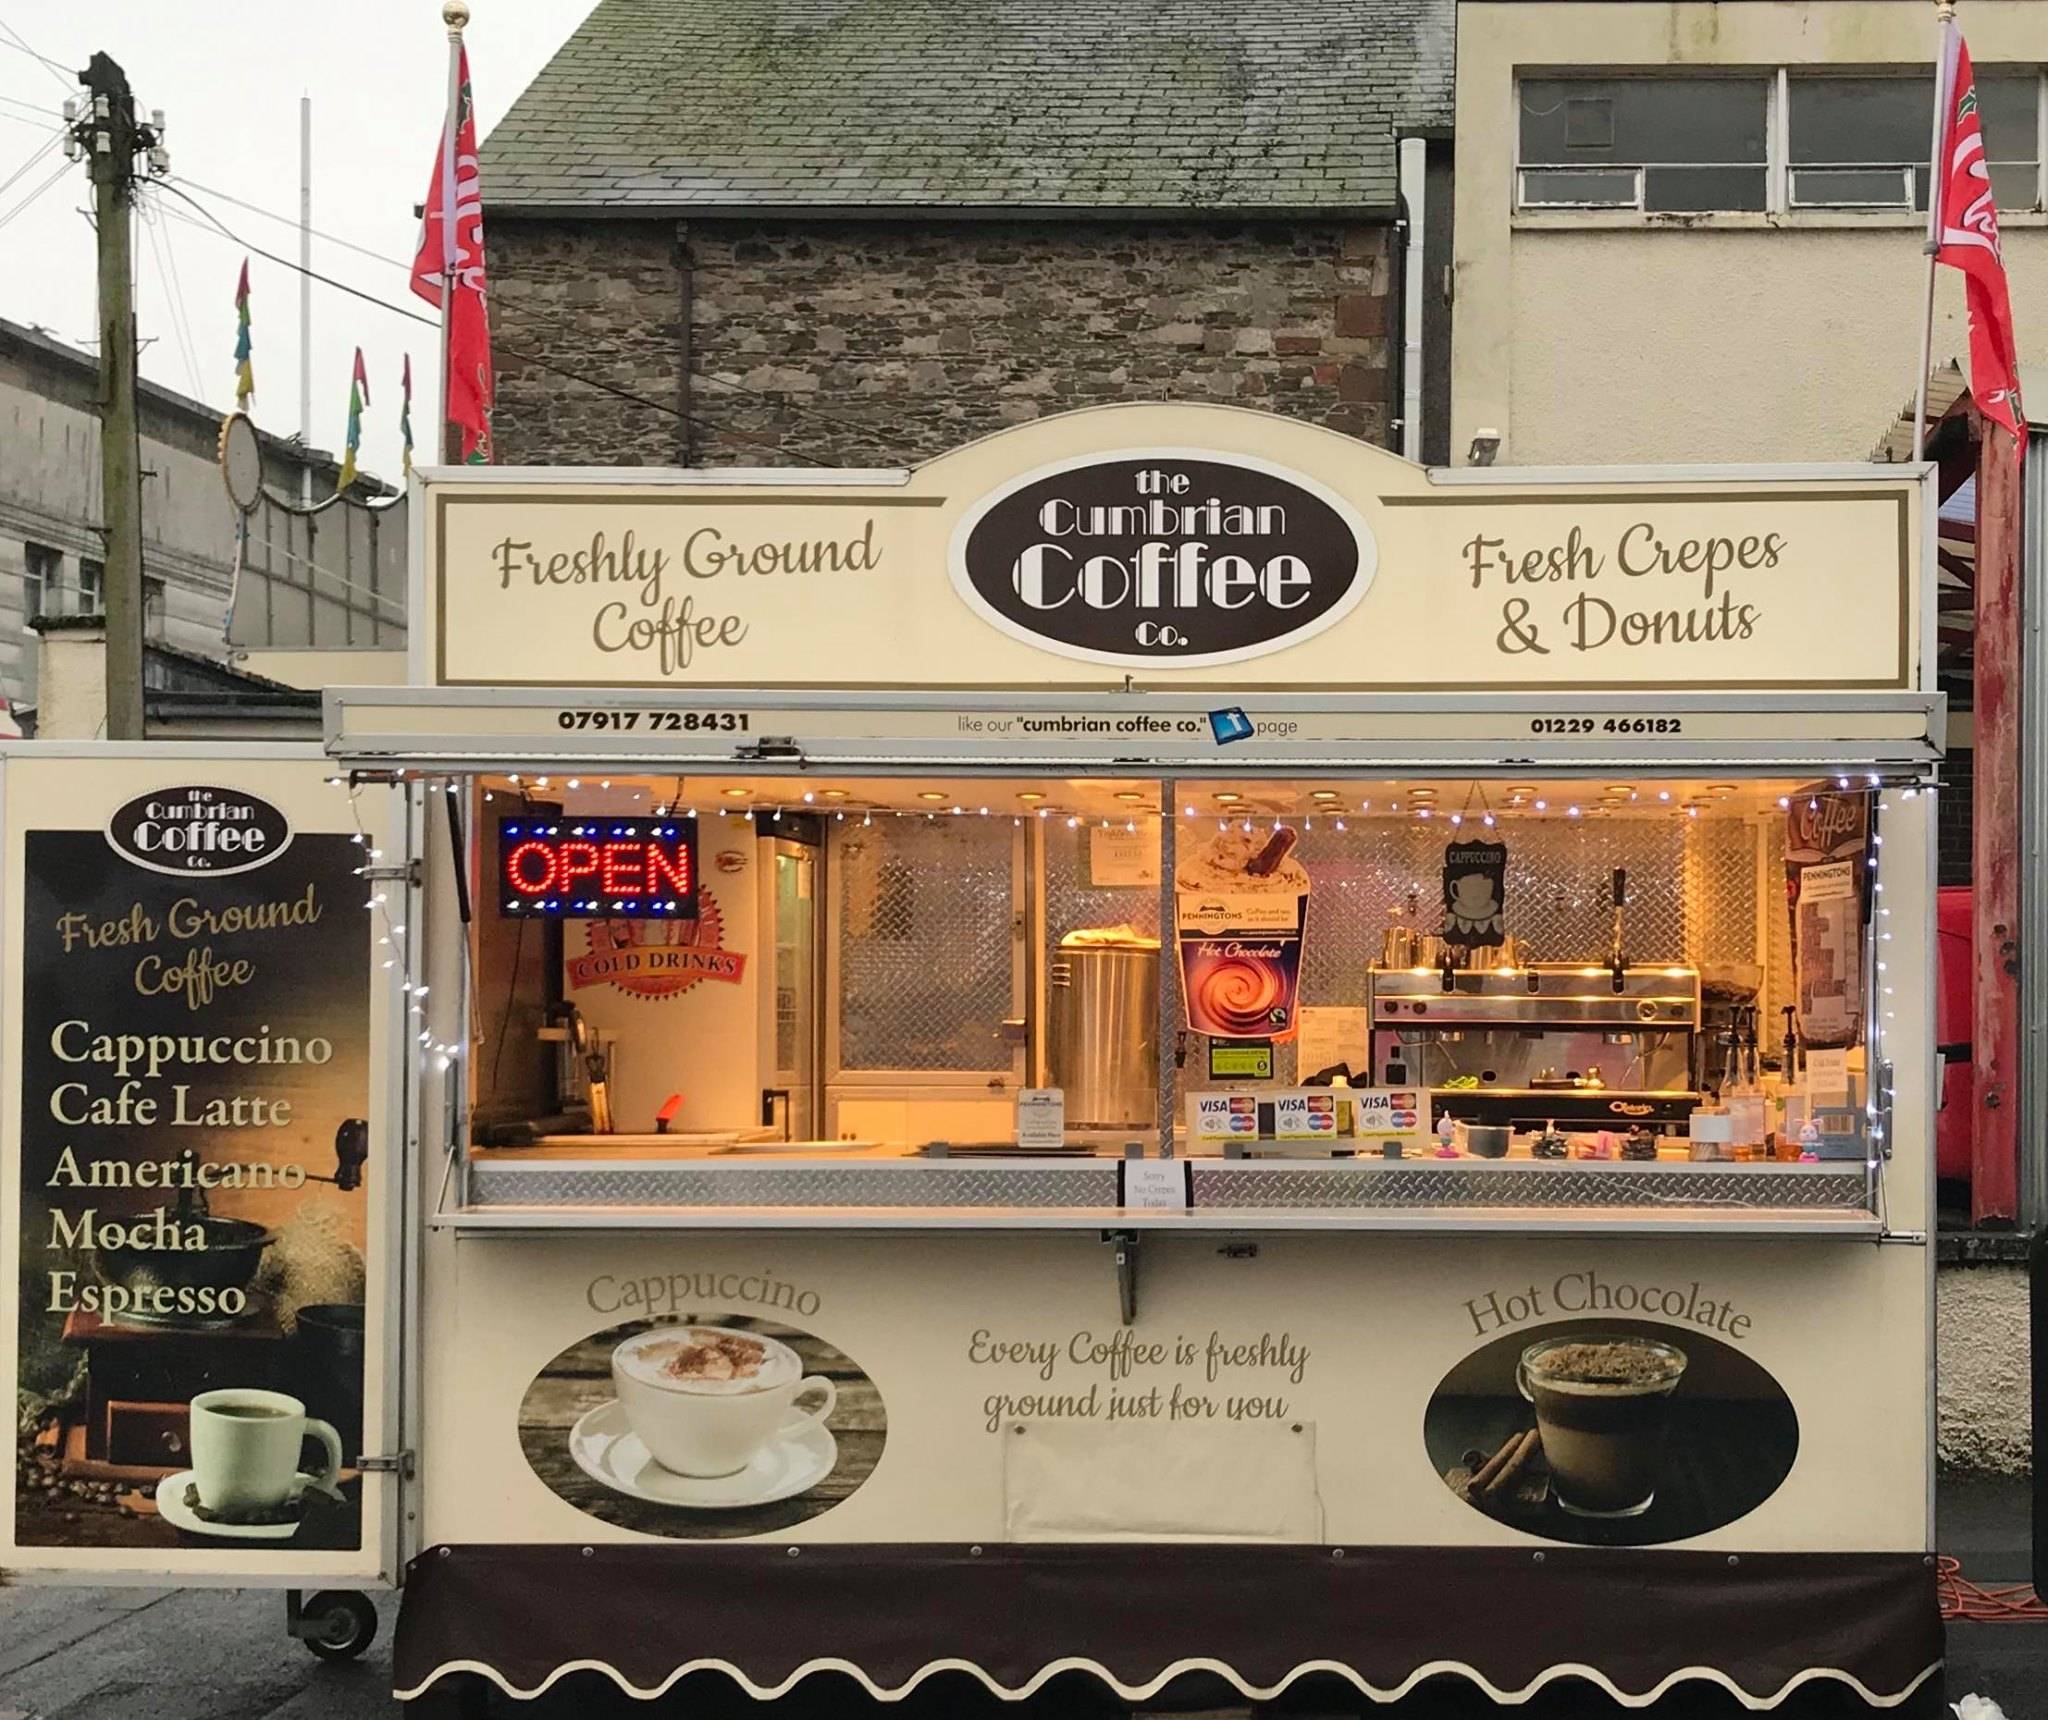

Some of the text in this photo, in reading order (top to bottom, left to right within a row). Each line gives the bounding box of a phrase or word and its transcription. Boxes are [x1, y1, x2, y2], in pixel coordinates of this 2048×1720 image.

[1134, 469, 1190, 495] the
[1039, 498, 1286, 536] Cumbrian
[492, 518, 882, 606] Freshly Ground
[1012, 541, 1312, 610] Coffee
[1462, 522, 1788, 600] Fresh Crepes
[593, 594, 749, 676] Coffee
[1135, 621, 1189, 647] Co.
[1496, 590, 1762, 655] & Donuts
[558, 711, 750, 731] 07917 728431
[958, 716, 983, 732] like
[987, 719, 1014, 732] our
[1016, 716, 1111, 733] "cumbrian
[1115, 716, 1172, 733] coffee
[1176, 716, 1207, 733] co."
[1257, 720, 1298, 737] page
[1531, 718, 1682, 733] 01229 466182
[145, 801, 255, 820] Cumbrian
[188, 789, 212, 802] the
[133, 820, 266, 852] Coffee
[1800, 797, 1857, 848] Coffee
[187, 855, 211, 868] Co.
[507, 840, 690, 896] OPEN
[56, 882, 323, 953] Fresh Ground
[1182, 911, 1243, 920] PENNINGTONS
[577, 952, 736, 978] COLD DRINKS
[1198, 941, 1282, 958] Hot Chocolate
[134, 946, 256, 1011] Coffee
[50, 1020, 333, 1077] Cappuccino
[49, 1081, 293, 1127] Cafe Latte
[1200, 1100, 1228, 1112] VISA
[1278, 1099, 1306, 1111] VISA
[1361, 1096, 1389, 1109] VISA
[45, 1145, 307, 1190] Americano
[46, 1206, 210, 1252] Mocha
[45, 1271, 248, 1328] Espresso
[586, 1269, 821, 1317] Cappuccino
[1462, 1270, 1752, 1339] Hot Chocolate
[968, 1329, 1312, 1384] Every Coffee is freshly
[983, 1382, 1290, 1433] ground just for you
